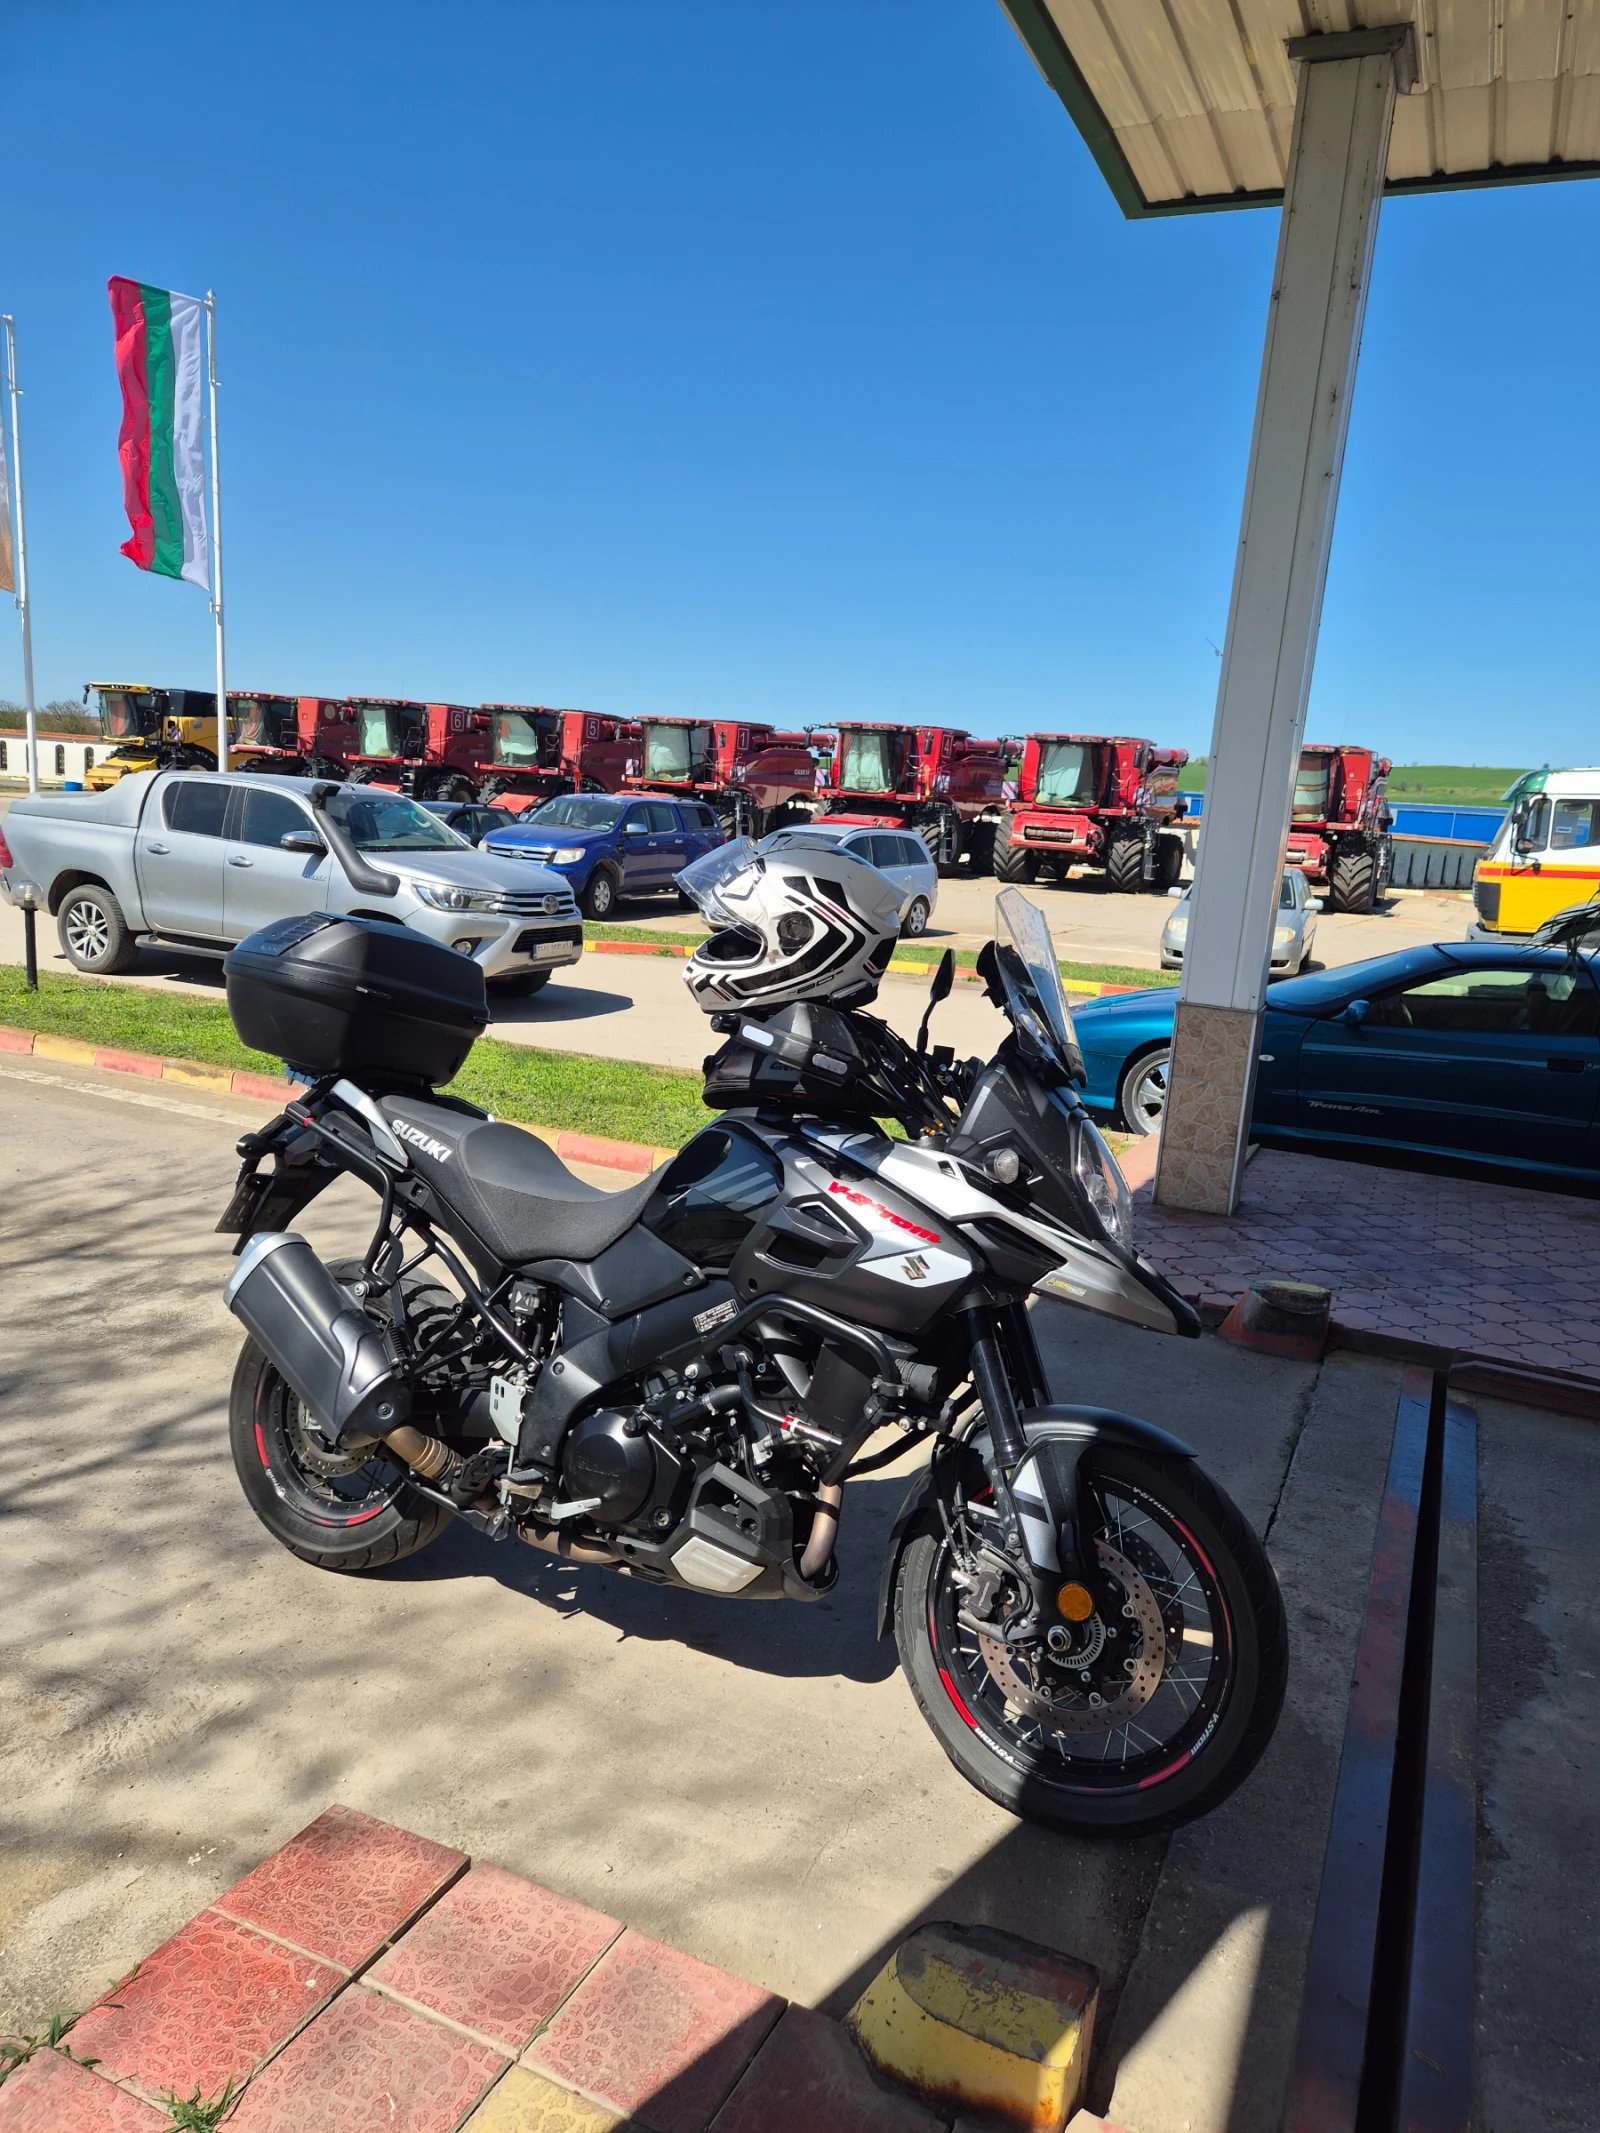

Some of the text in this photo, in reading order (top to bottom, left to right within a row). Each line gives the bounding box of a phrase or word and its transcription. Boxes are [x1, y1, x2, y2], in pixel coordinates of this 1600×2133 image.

[454, 713, 461, 729] 6
[589, 721, 597, 736] 5
[1307, 1100, 1384, 1116] Trans Am
[391, 1119, 453, 1163] SUZUKI
